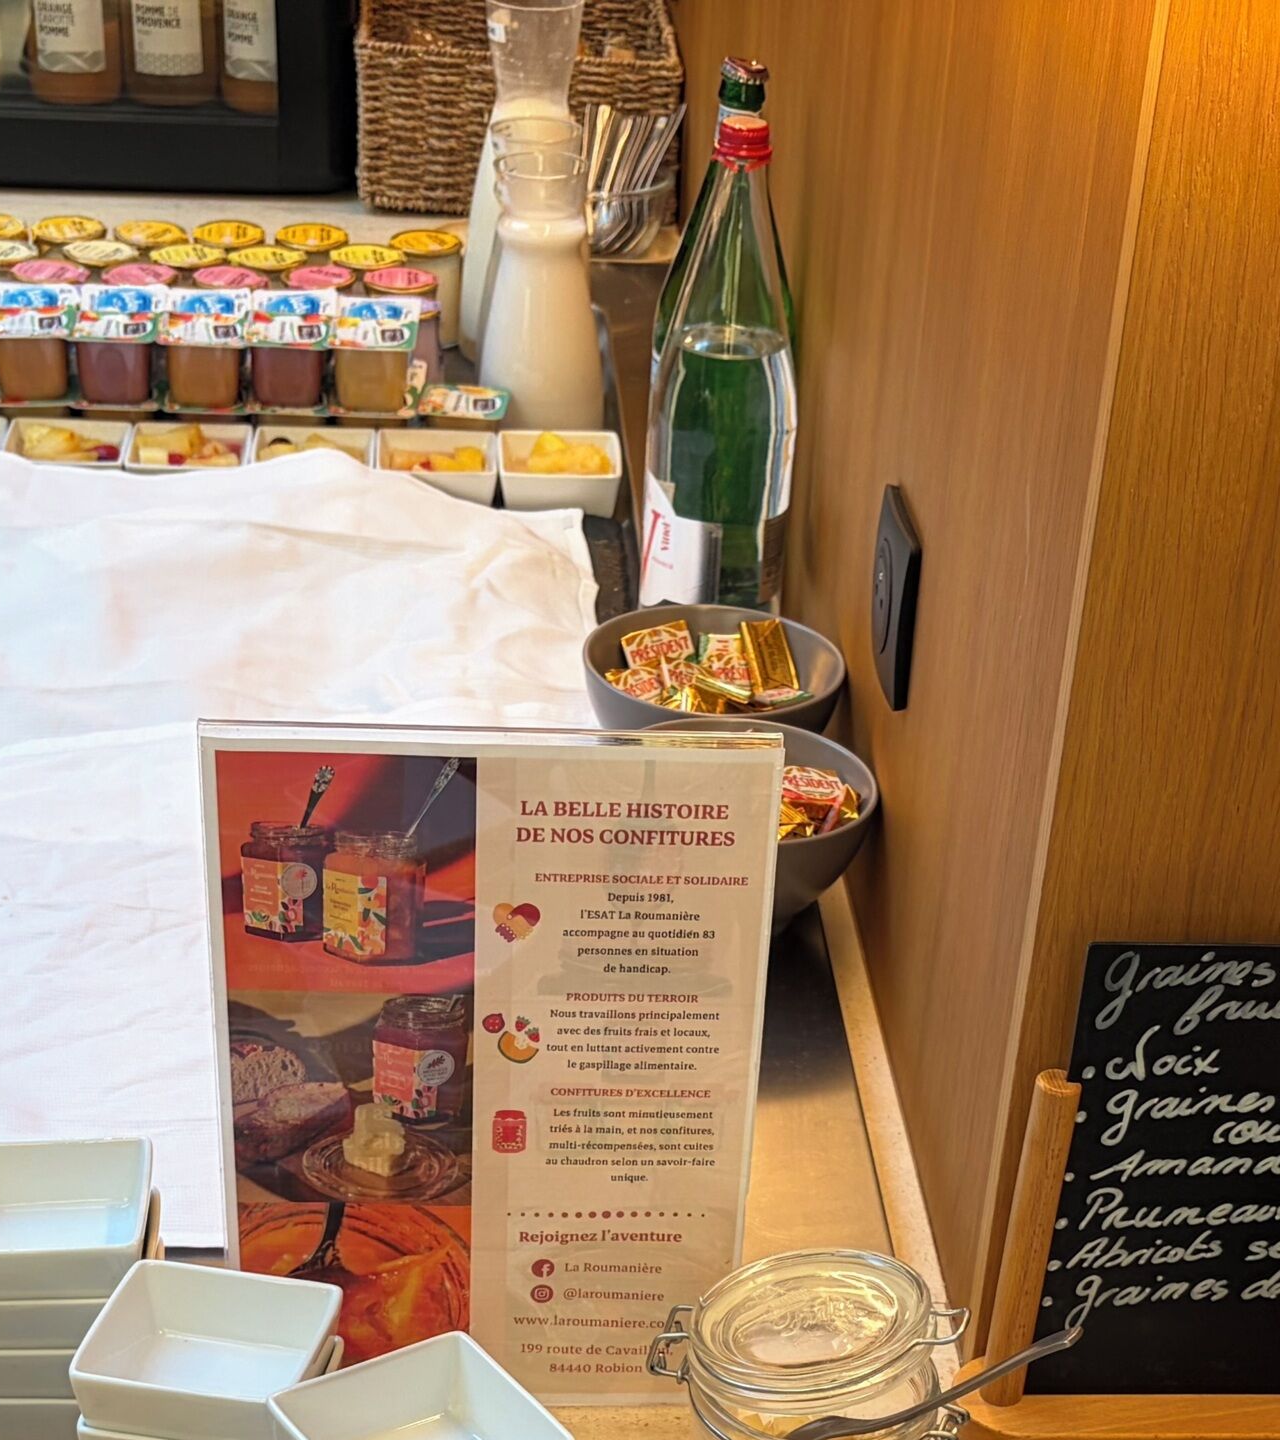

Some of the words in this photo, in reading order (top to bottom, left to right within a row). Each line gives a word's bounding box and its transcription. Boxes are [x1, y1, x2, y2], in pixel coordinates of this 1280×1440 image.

[630, 636, 689, 663] PRÉSIDENT
[520, 800, 548, 817] LA
[554, 802, 621, 817] BELLE
[626, 803, 729, 819] HISTOIRE
[516, 827, 545, 843] DE
[551, 828, 594, 843] NOS
[599, 829, 735, 847] CONFITURES
[535, 873, 609, 883] ENTREPRISE
[612, 874, 664, 885] SOCIALE
[666, 875, 682, 885] ET
[683, 876, 749, 886] SOLIDAIRE
[607, 892, 645, 905] Depuis
[648, 893, 674, 904] 1981,
[580, 909, 616, 920] l'ESAT
[618, 911, 631, 921] La
[634, 911, 700, 921] Roumanière
[562, 929, 630, 941] accompagne
[632, 930, 645, 938] au
[703, 930, 715, 940] 83
[577, 947, 632, 957] personnes
[635, 948, 648, 956] en
[651, 947, 699, 957] situation
[603, 964, 617, 973] de
[619, 964, 671, 976] handicap.
[566, 992, 625, 1003] PRODUITS
[628, 993, 645, 1003] DU
[648, 994, 698, 1004] TERROIR
[550, 1009, 577, 1019] Nous
[579, 1010, 636, 1020] travaillons
[638, 1010, 720, 1022] principalement
[557, 1028, 581, 1036] avec
[583, 1026, 601, 1036] des
[604, 1027, 632, 1037] fruits
[634, 1027, 657, 1037] frais
[660, 1028, 670, 1037] et
[673, 1027, 711, 1039] locaux,
[546, 1043, 568, 1052] tout
[570, 1044, 583, 1052] en
[586, 1043, 622, 1053] luttant
[624, 1044, 683, 1054] activement
[686, 1045, 720, 1054] contre
[567, 1060, 577, 1070] le
[579, 1060, 631, 1072] gaspillage
[634, 1061, 697, 1071] alimentaire.
[550, 1087, 623, 1097] CONFITURES
[625, 1088, 711, 1099] D'EXCELLENCE
[553, 1109, 570, 1118] Les
[573, 1109, 601, 1118] fruits
[603, 1110, 626, 1119] sont
[628, 1109, 713, 1119] minutieusement
[550, 1124, 573, 1134] triés
[575, 1124, 581, 1134] à
[583, 1124, 593, 1134] la
[595, 1125, 624, 1135] main,
[627, 1126, 637, 1135] et
[639, 1126, 658, 1135] nos
[660, 1125, 714, 1136] confitures,
[549, 1140, 656, 1152] multi-récompensées,
[659, 1142, 681, 1151] sont
[683, 1141, 714, 1151] cuites
[545, 1157, 558, 1166] au
[560, 1157, 608, 1166] chaudron
[611, 1157, 638, 1167] selon
[640, 1158, 654, 1166] un
[656, 1157, 715, 1167] savoir-faire
[611, 1173, 648, 1183] unique.
[519, 1231, 597, 1245] Rejoignez
[601, 1230, 682, 1242] l'aventure
[1065, 1229, 1225, 1272] Abricots
[564, 1262, 581, 1272] La
[583, 1262, 662, 1274] Roumanière
[563, 1287, 664, 1302] @laroumaniere
[514, 1315, 667, 1329] www.laroumaniere.co
[520, 1343, 543, 1354] 199
[547, 1344, 583, 1355] route
[586, 1345, 604, 1355] de
[550, 1363, 591, 1373] 84440
[596, 1363, 642, 1374] Robion
